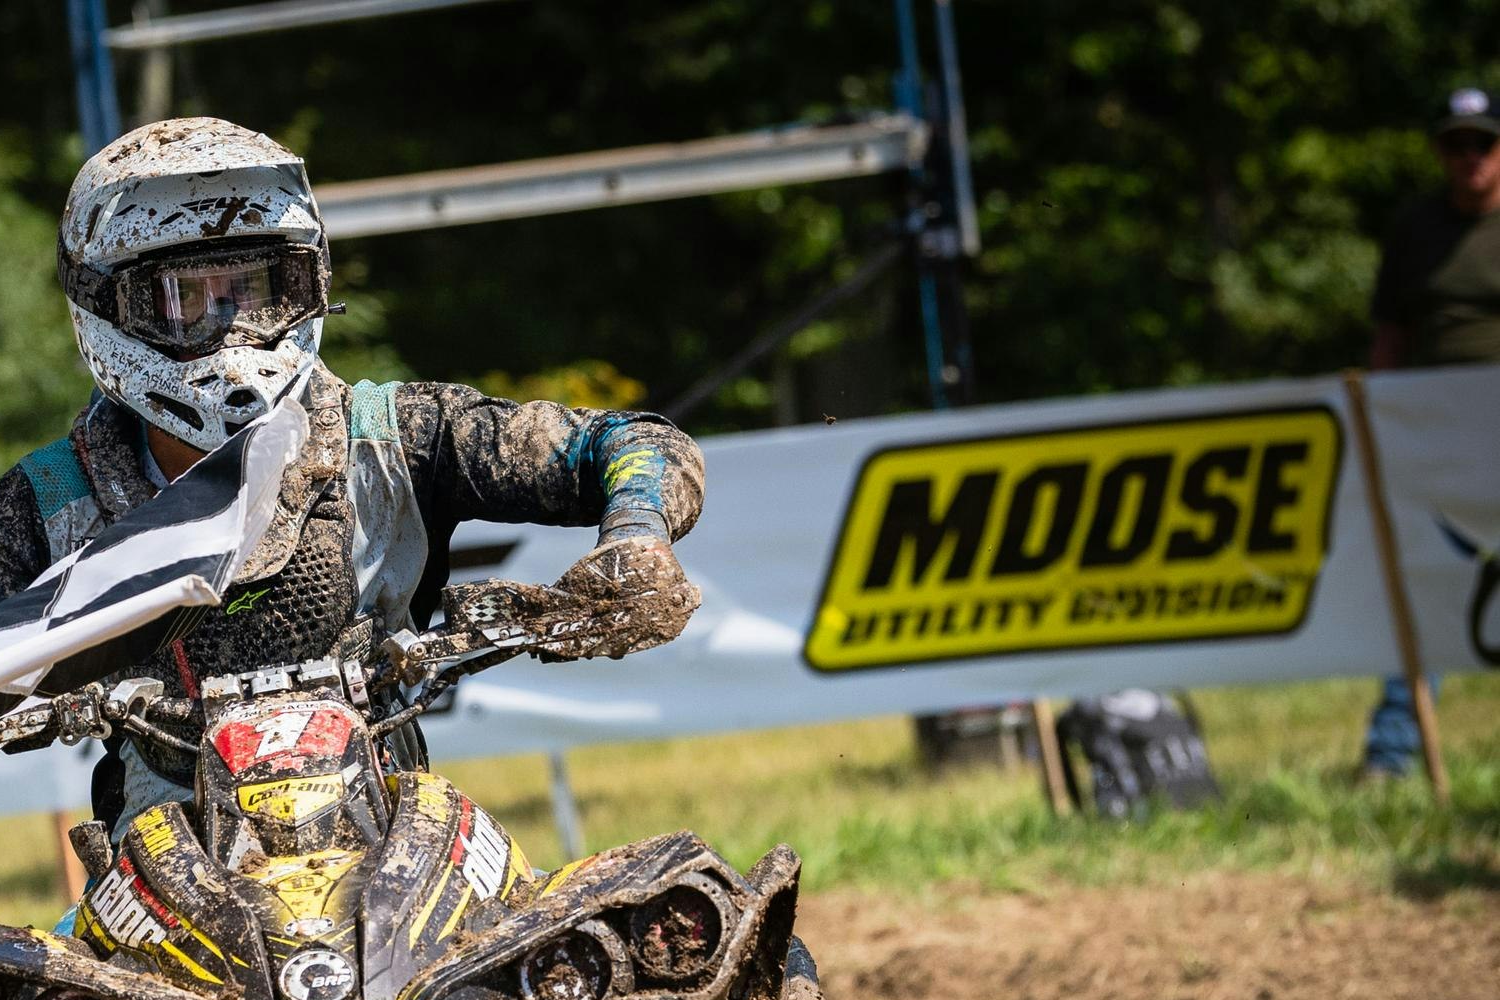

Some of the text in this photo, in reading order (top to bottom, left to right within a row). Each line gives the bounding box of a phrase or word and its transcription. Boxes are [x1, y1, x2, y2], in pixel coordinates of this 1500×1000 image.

[861, 441, 1310, 592] MOOSE
[840, 576, 1289, 647] UTILITY DIVISION
[311, 974, 351, 988] BRP
